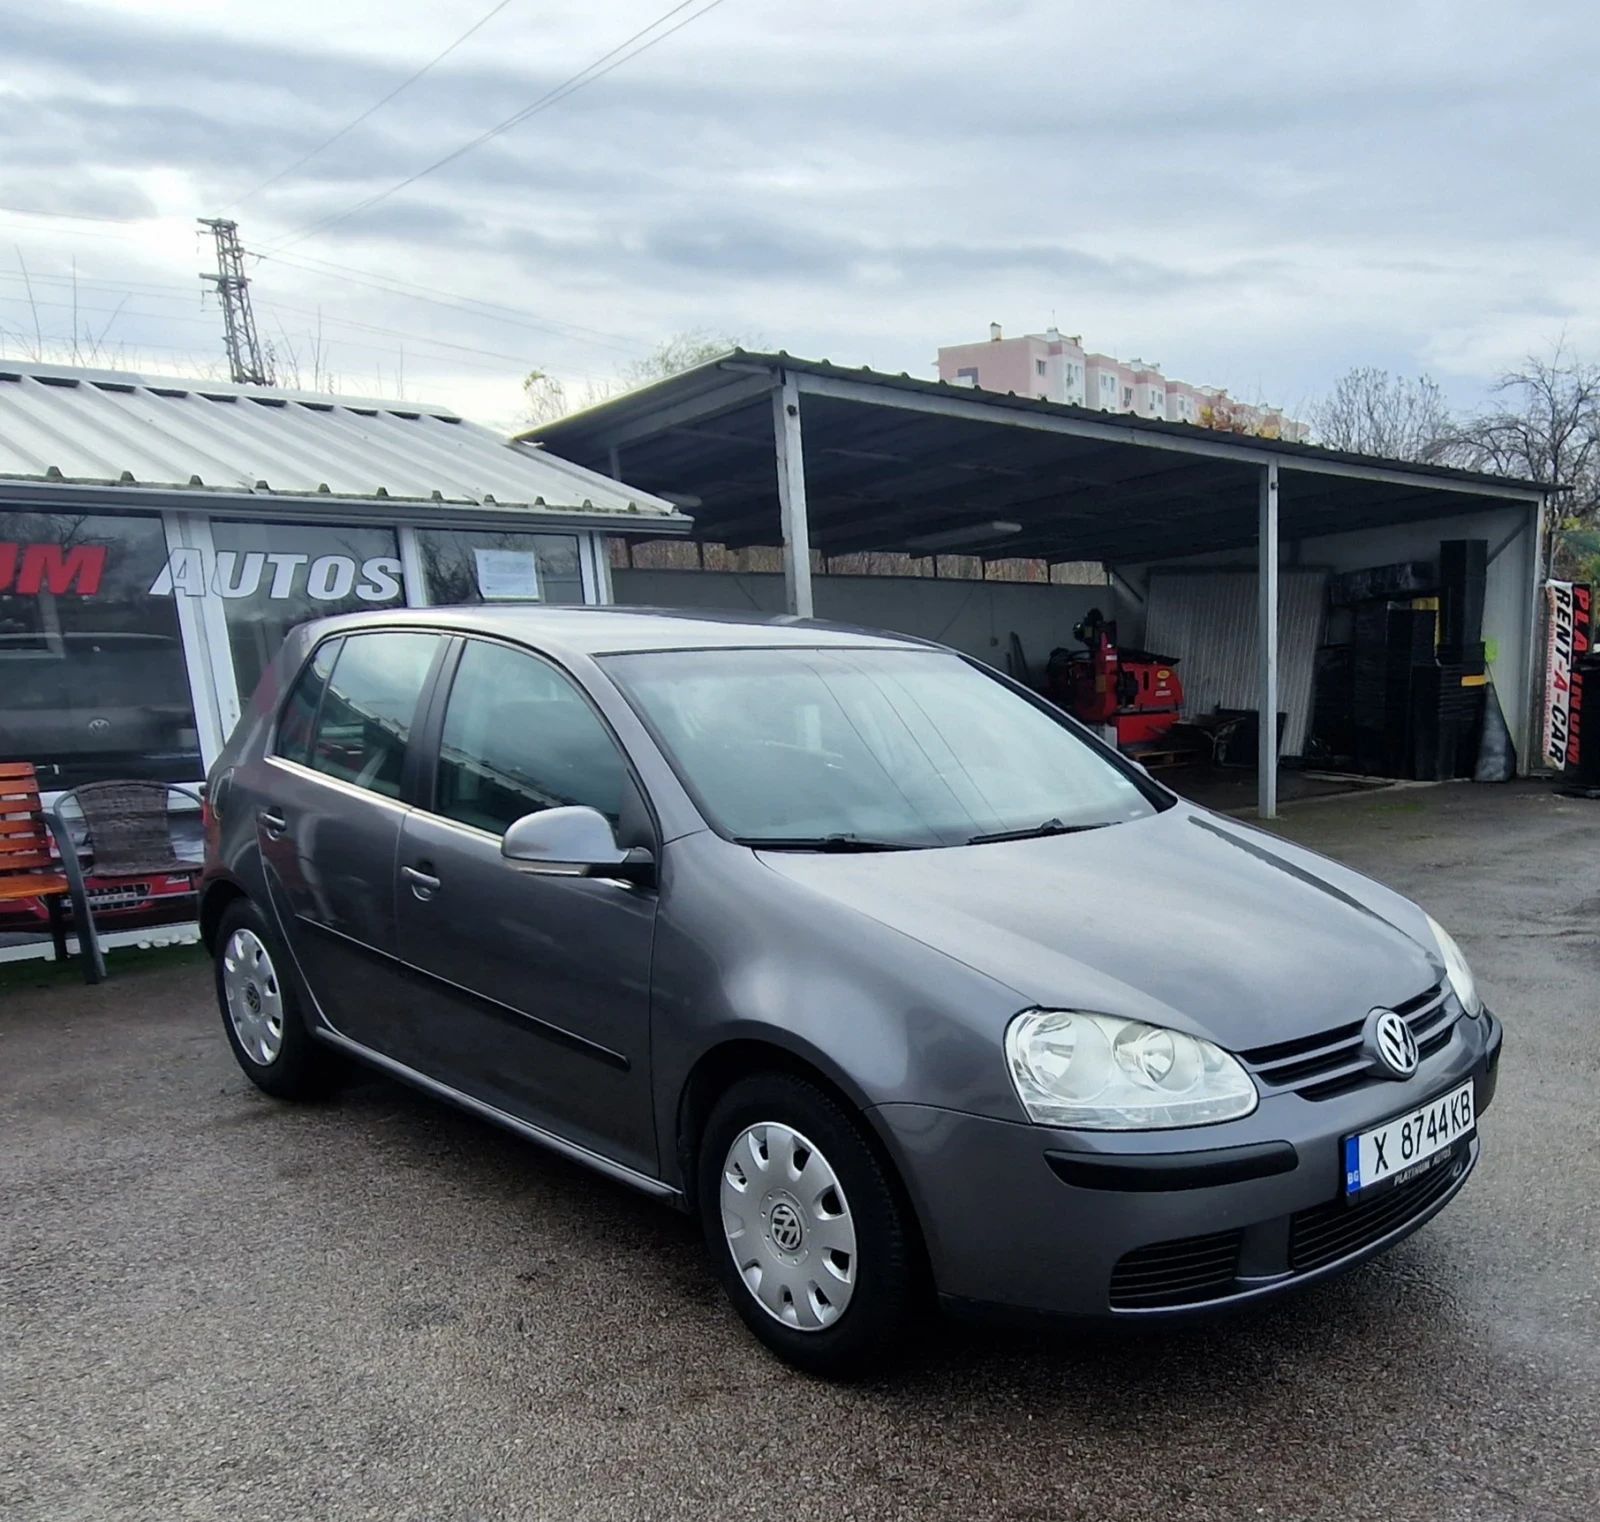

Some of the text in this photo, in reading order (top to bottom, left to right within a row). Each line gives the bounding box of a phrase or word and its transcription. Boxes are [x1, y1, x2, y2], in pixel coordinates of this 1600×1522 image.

[148, 548, 402, 601] AUTOS
[1549, 586, 1571, 763] RENT-A-CAR
[1566, 586, 1590, 765] PLAINUM
[1347, 1170, 1359, 1185] BG
[1374, 1131, 1389, 1175] X
